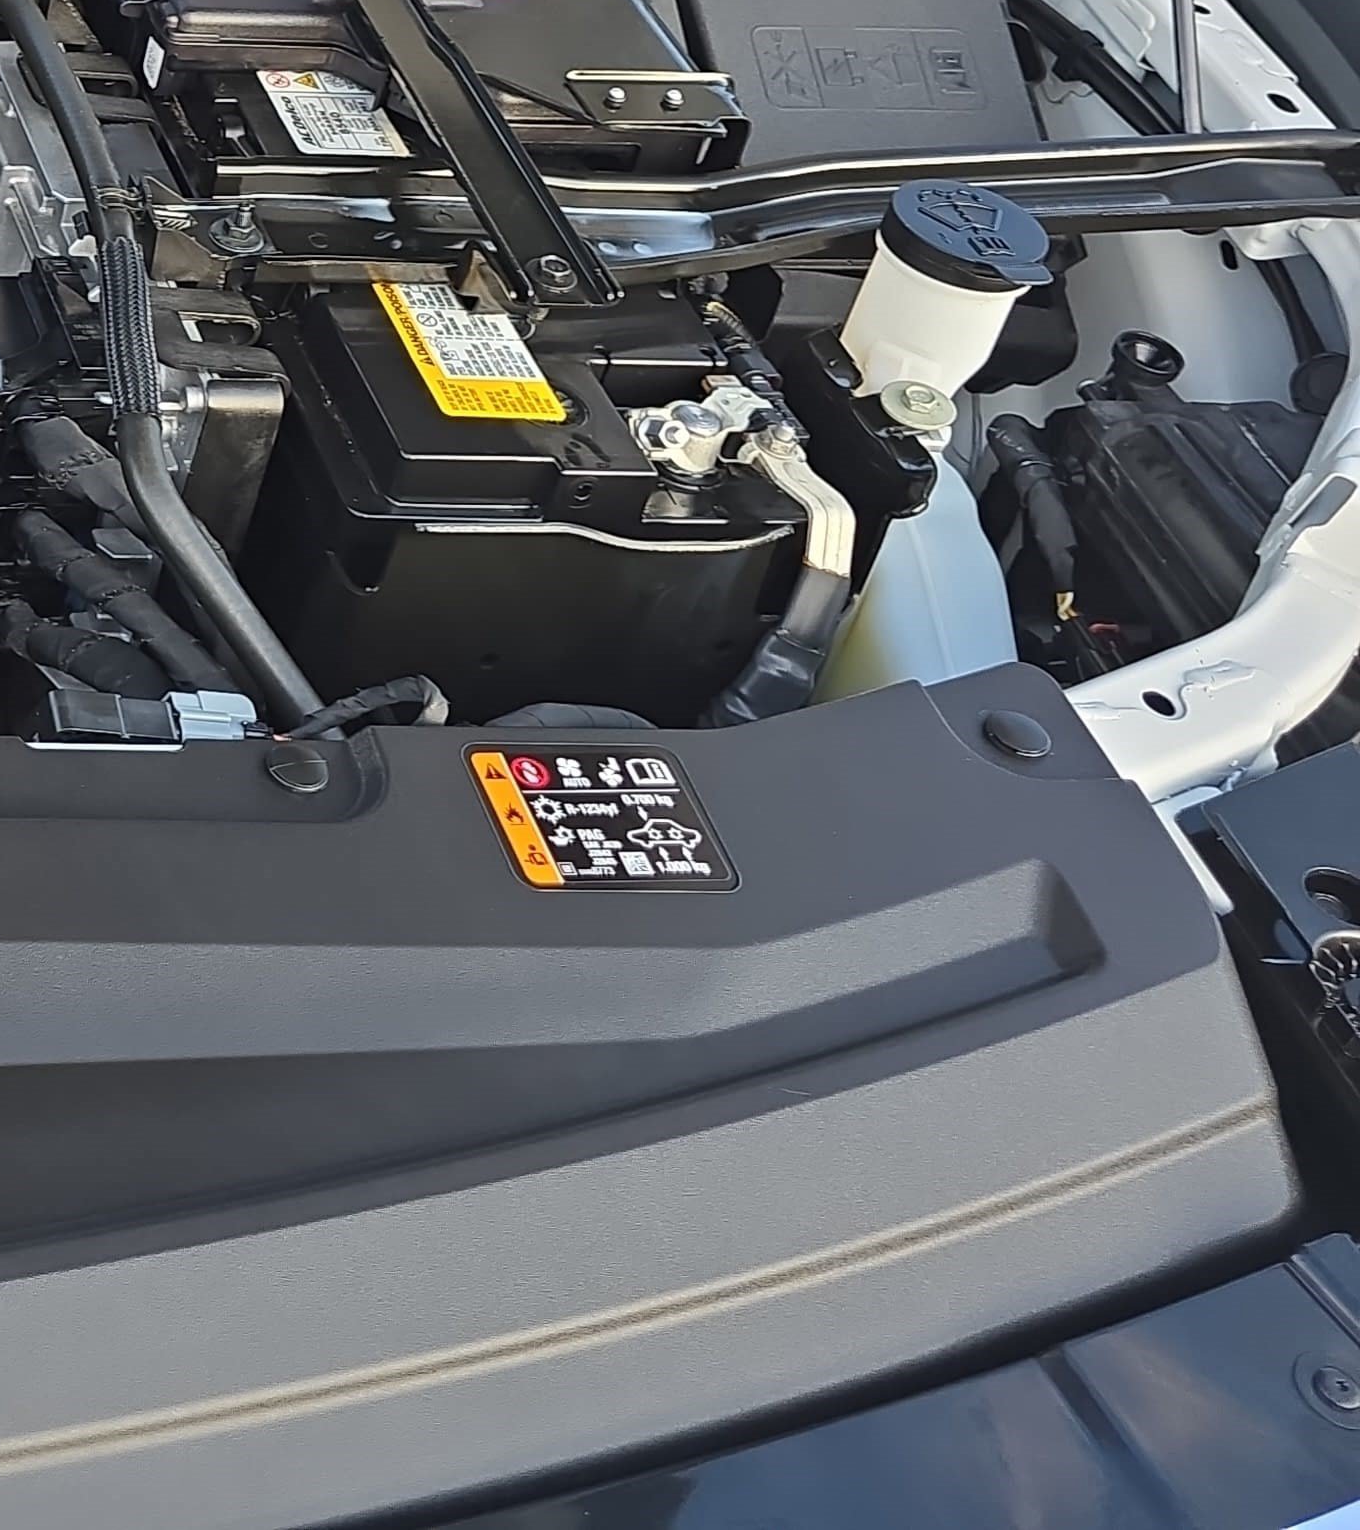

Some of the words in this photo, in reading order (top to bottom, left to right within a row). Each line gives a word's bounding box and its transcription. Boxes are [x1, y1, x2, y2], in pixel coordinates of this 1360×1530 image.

[281, 96, 317, 146] ACDelco
[399, 315, 428, 359] DANGER
[576, 829, 606, 841] PAG
